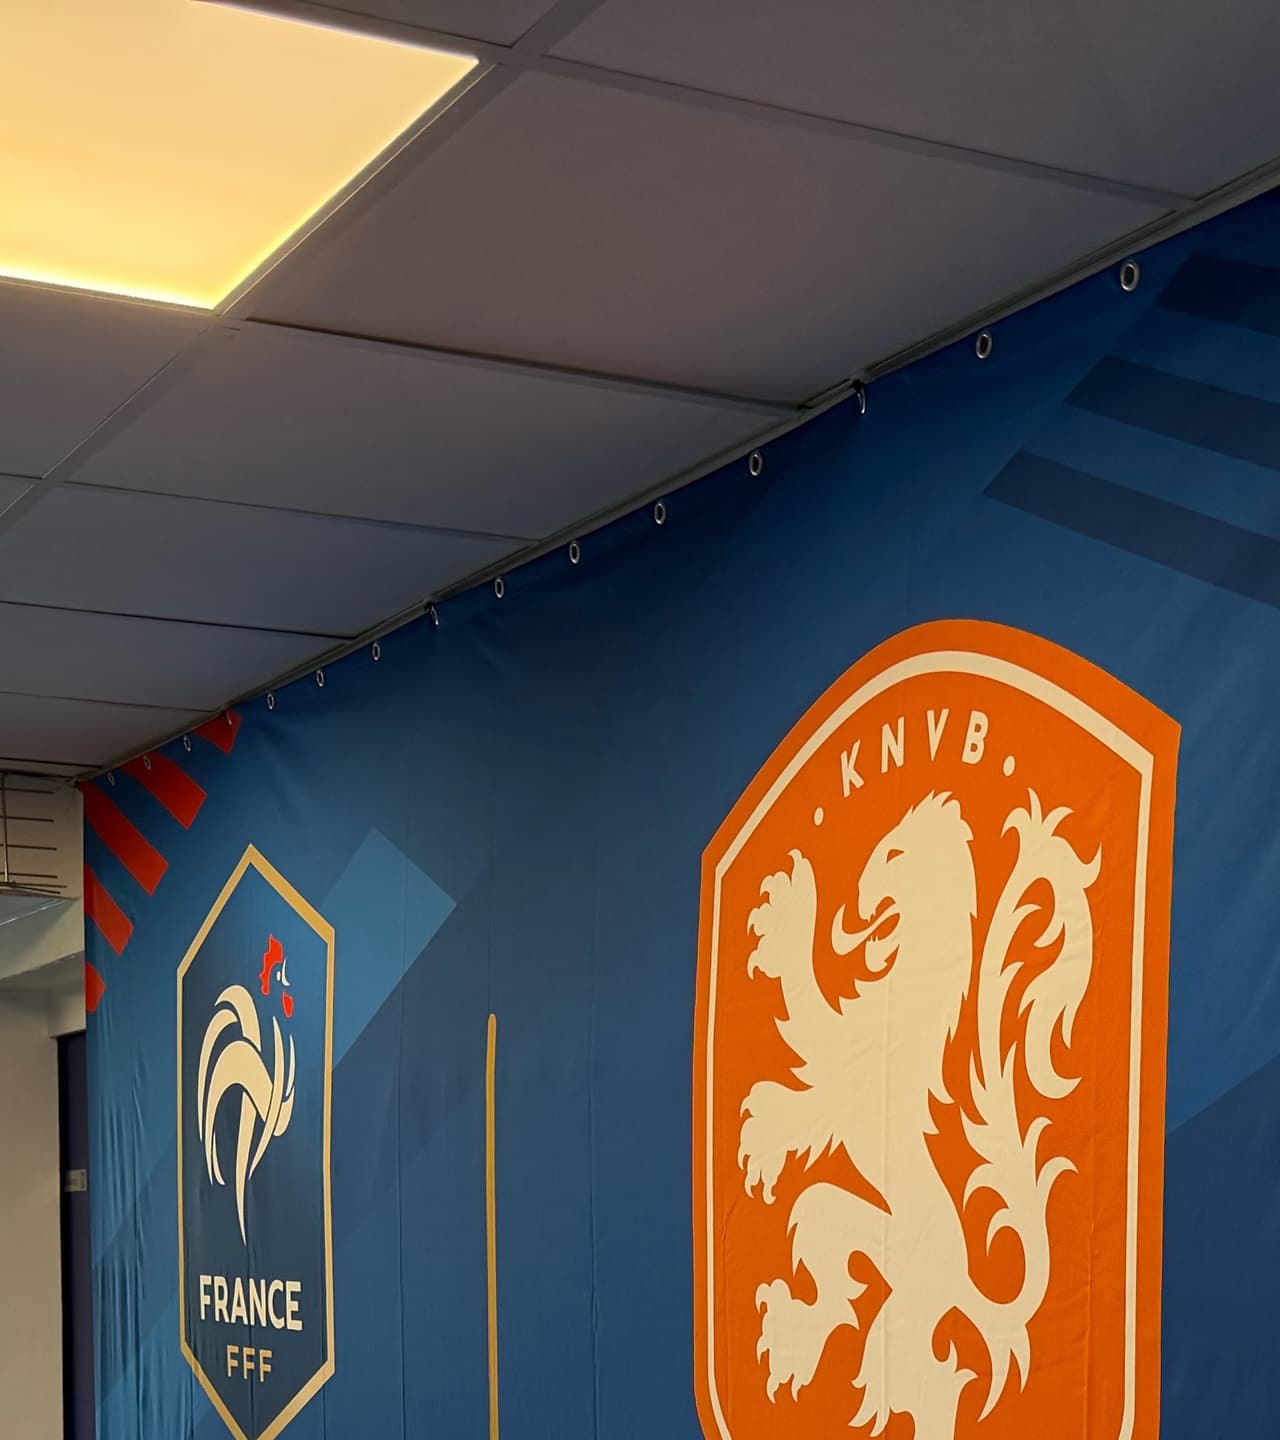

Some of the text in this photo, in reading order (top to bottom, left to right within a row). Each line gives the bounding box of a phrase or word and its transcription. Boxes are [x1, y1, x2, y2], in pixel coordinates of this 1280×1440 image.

[841, 708, 988, 798] KNVB
[200, 1275, 303, 1331] FRANCE
[227, 1345, 272, 1382] FFF
